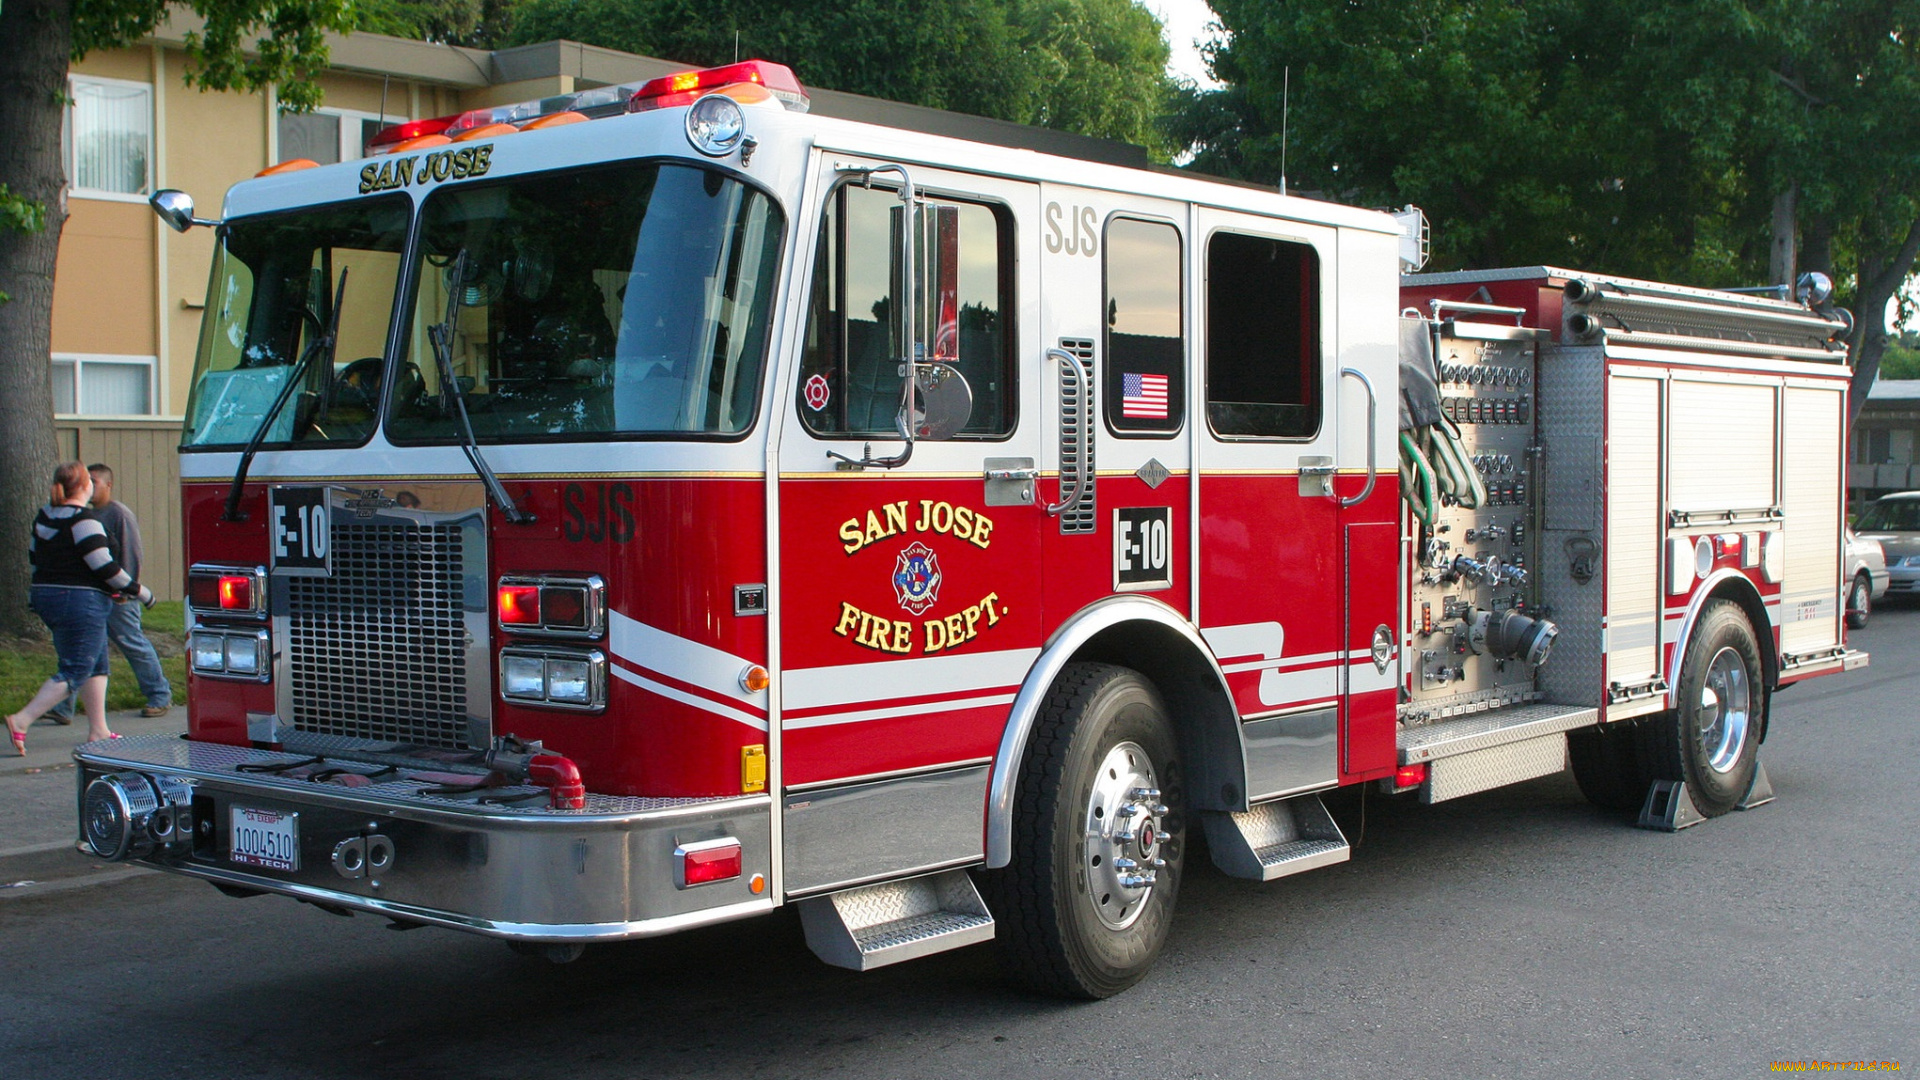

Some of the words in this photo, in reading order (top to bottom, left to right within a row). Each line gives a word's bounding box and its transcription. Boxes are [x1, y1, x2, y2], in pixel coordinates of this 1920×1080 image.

[359, 156, 419, 194] SAN
[417, 144, 494, 185] JOSE
[1045, 201, 1098, 258] SJS
[273, 504, 326, 558] E-10
[564, 483, 635, 543] SJS
[839, 500, 909, 556] SAN
[914, 499, 994, 549] JOSE
[1119, 519, 1166, 571] E-10
[834, 602, 913, 654] FIRE
[923, 592, 1009, 654] DEPT.
[235, 826, 292, 860] 1004510
[247, 813, 255, 821] CA
[258, 858, 290, 870] TECH
